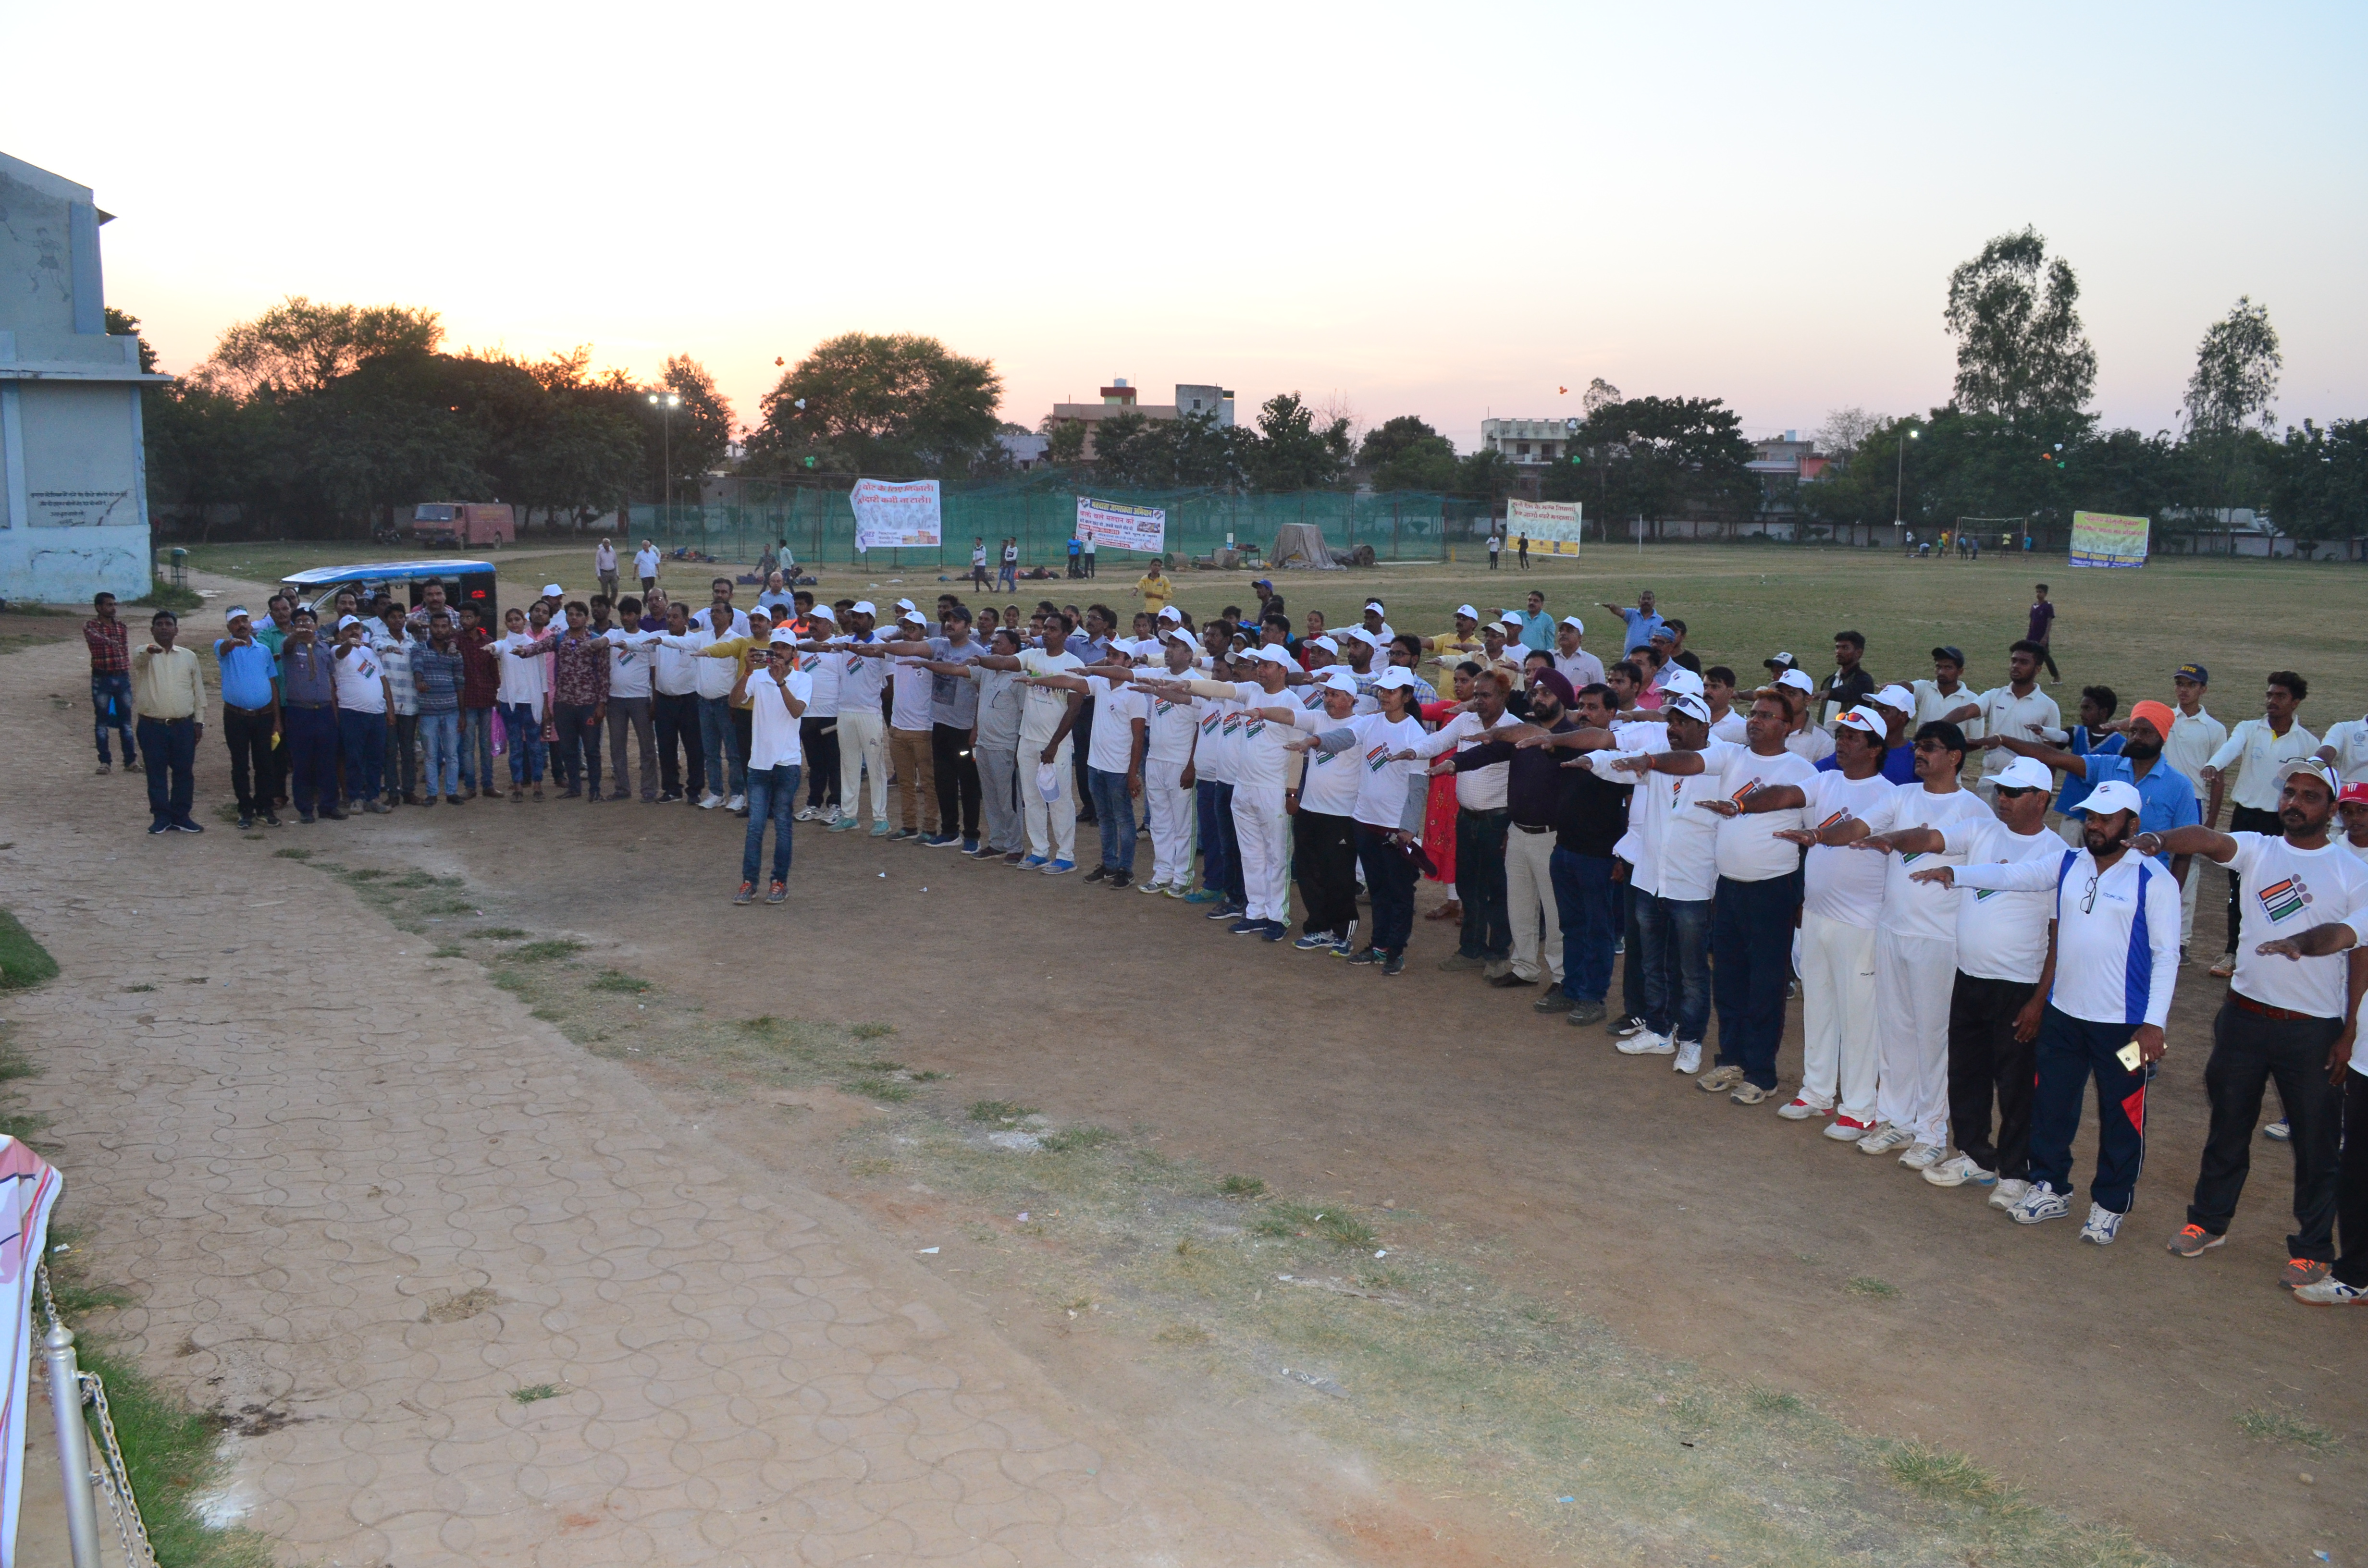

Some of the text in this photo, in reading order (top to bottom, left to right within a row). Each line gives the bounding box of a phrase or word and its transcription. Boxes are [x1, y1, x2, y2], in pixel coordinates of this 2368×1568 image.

[863, 482, 876, 490] वोट
[1091, 501, 1109, 511] मतदाता
[1134, 507, 1152, 517] अभियान
